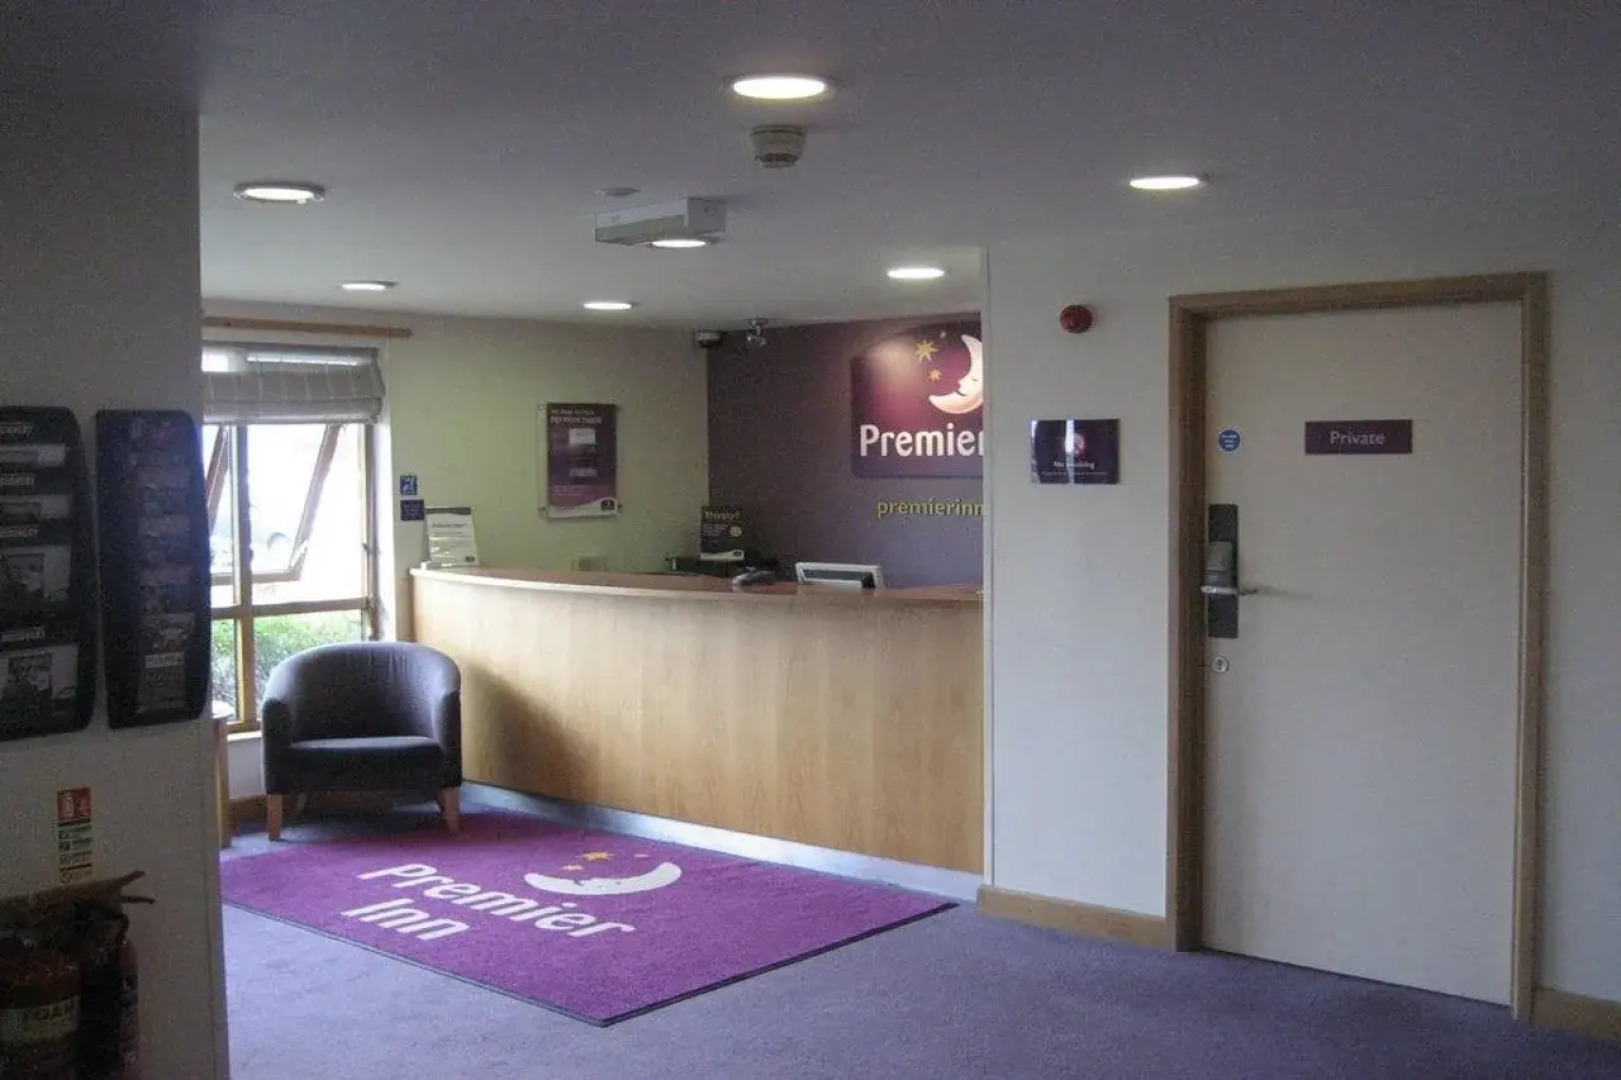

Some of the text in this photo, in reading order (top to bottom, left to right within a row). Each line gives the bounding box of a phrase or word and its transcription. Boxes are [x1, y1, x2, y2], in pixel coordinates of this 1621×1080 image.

[1330, 430, 1385, 445] Private
[340, 898, 470, 940] Inn
[357, 863, 636, 938] Premier
